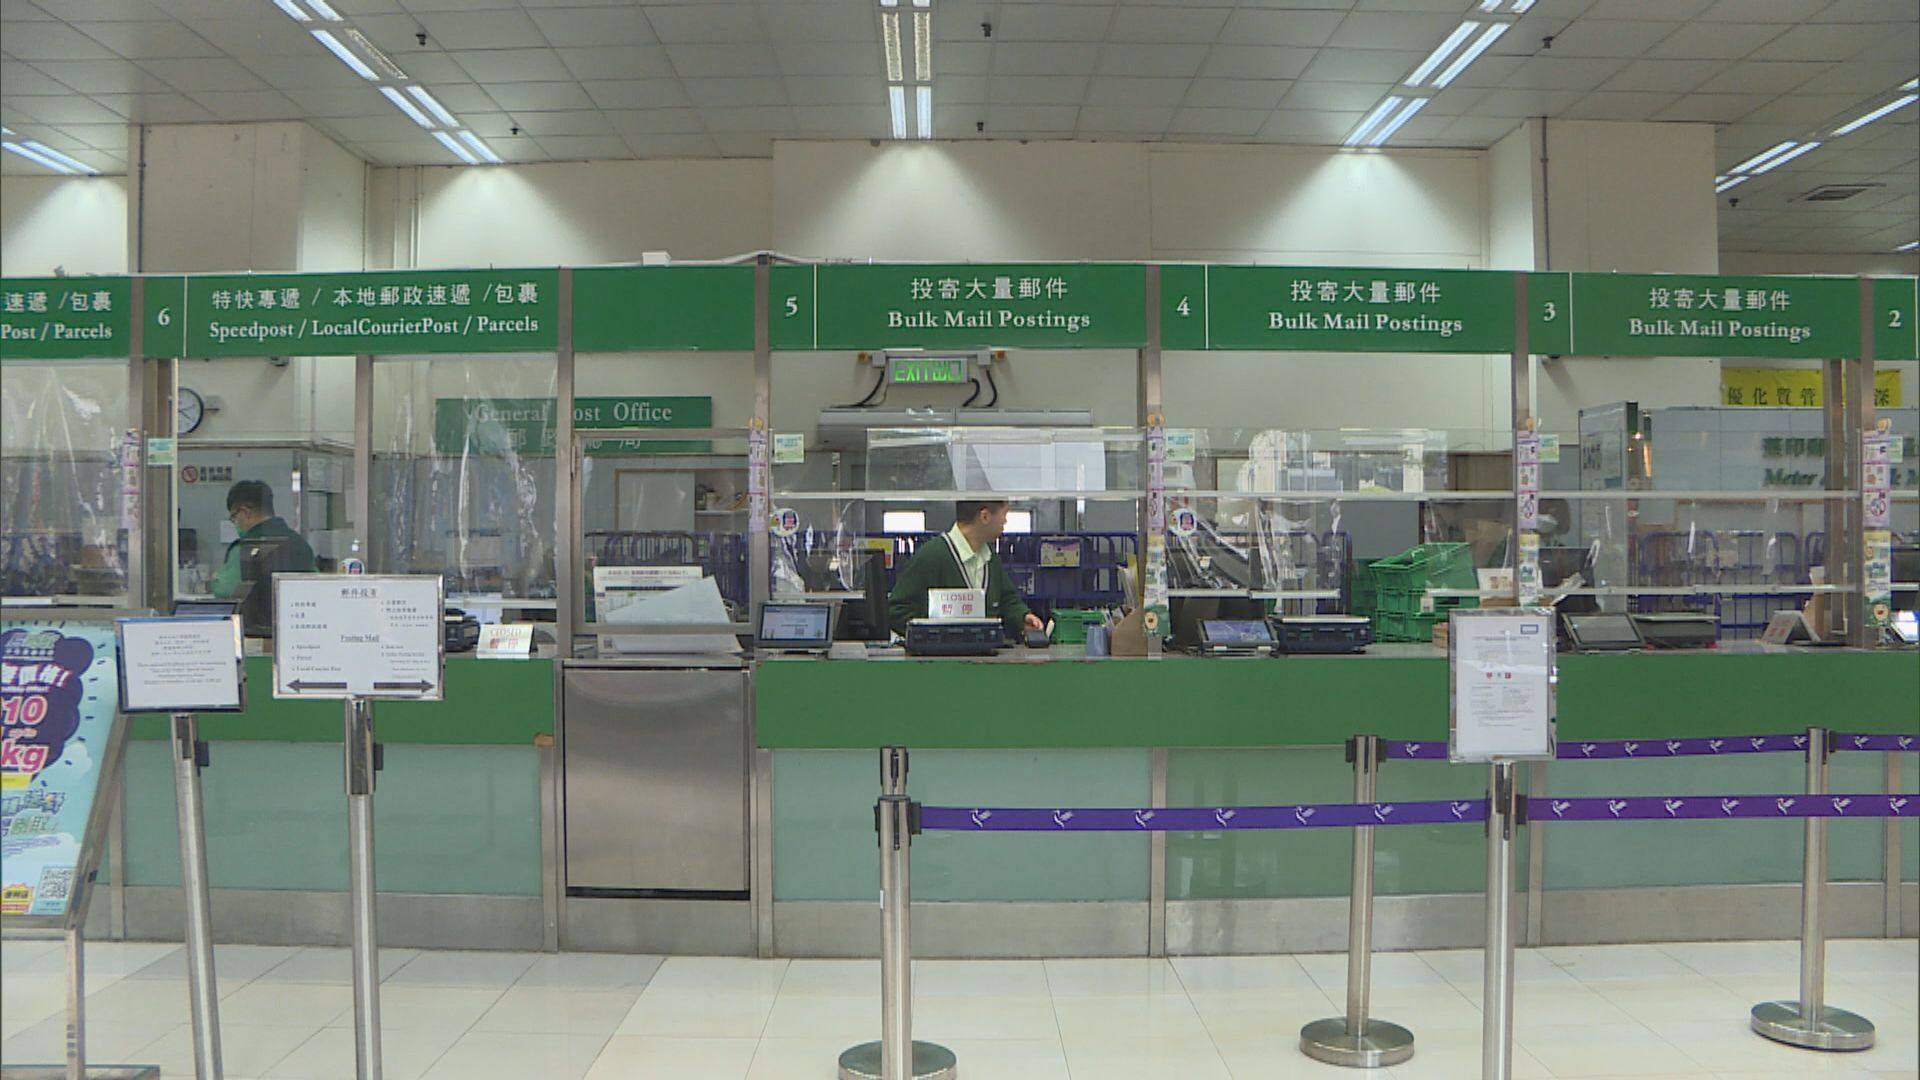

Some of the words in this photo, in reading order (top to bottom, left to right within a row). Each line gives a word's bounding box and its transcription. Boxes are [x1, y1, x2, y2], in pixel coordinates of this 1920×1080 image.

[212, 288, 300, 309] 特快專遞
[333, 284, 471, 307] 本地郵政速遞
[910, 277, 1068, 299] 投寄大量郵件
[1290, 280, 1442, 304] 投寄大量郵件
[785, 297, 798, 317] 5
[1176, 297, 1191, 316] 4
[1649, 288, 1792, 312] 投寄大量郵件
[158, 308, 170, 325] 6
[888, 311, 939, 328] Bulk
[944, 310, 993, 328] Mail
[998, 310, 1091, 332] Postings
[1543, 302, 1556, 321] 3
[1888, 310, 1902, 328] 2
[54, 322, 113, 339] Parcels
[210, 321, 295, 343] Speedpost
[311, 317, 459, 336] LocalCourierPost
[477, 315, 539, 332] Parcels
[1268, 312, 1318, 330] Bulk
[1323, 313, 1370, 330] Mail
[1375, 314, 1463, 336] Postings
[1629, 318, 1675, 335] Bulk
[1680, 319, 1724, 336] Mail
[1728, 320, 1811, 343] Postings
[474, 402, 547, 422] General
[575, 406, 601, 421] ost
[613, 402, 673, 421] Office
